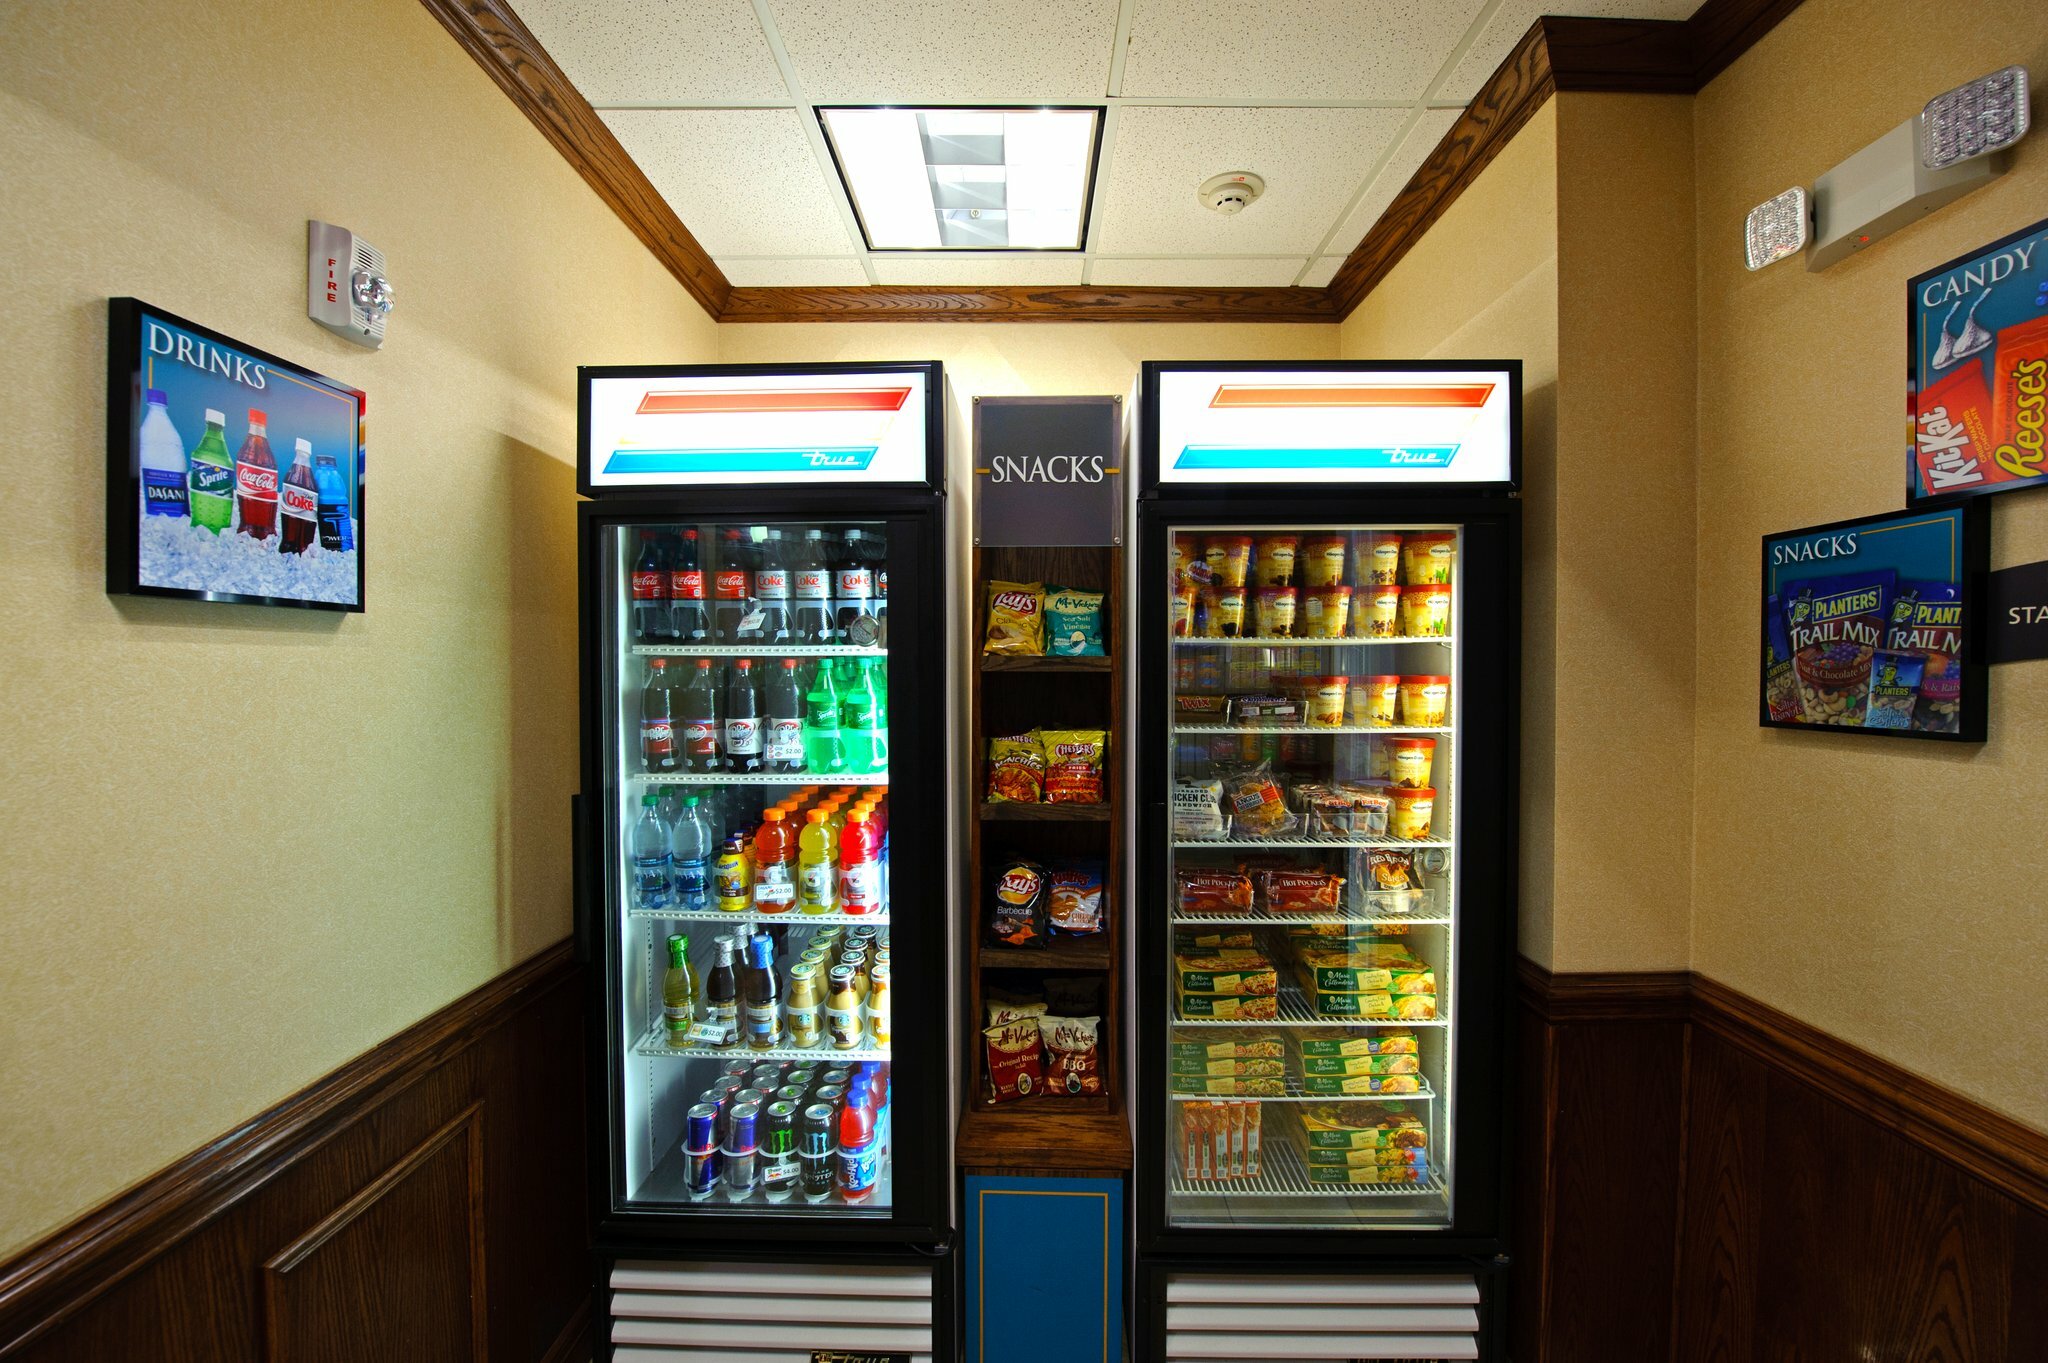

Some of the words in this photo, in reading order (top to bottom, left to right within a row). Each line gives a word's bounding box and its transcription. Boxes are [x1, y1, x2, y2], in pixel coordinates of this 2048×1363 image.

[327, 258, 338, 303] FIRE
[1923, 240, 2037, 307] CANDY
[148, 322, 267, 390] DRINKS
[991, 455, 1104, 483] SNACKS
[199, 471, 229, 487] Sprite
[148, 487, 185, 500] DASANI
[286, 490, 314, 511] Coke
[1774, 533, 1857, 565] SNACKS
[757, 575, 784, 586] Coke
[1815, 591, 1878, 619] PLANTERS
[1789, 622, 1841, 650] TRAIL
[1842, 620, 1881, 648] MIX
[1820, 669, 1859, 680] Chocolate
[1875, 686, 1909, 696] PLANTERS
[1177, 696, 1211, 710] Twix
[994, 756, 1043, 770] MNCHIES
[1200, 793, 1217, 804] CL
[997, 905, 1033, 916] Barbecue
[998, 1057, 1021, 1069] Original
[1021, 1054, 1040, 1062] Recip
[1063, 1059, 1086, 1071] BBQ
